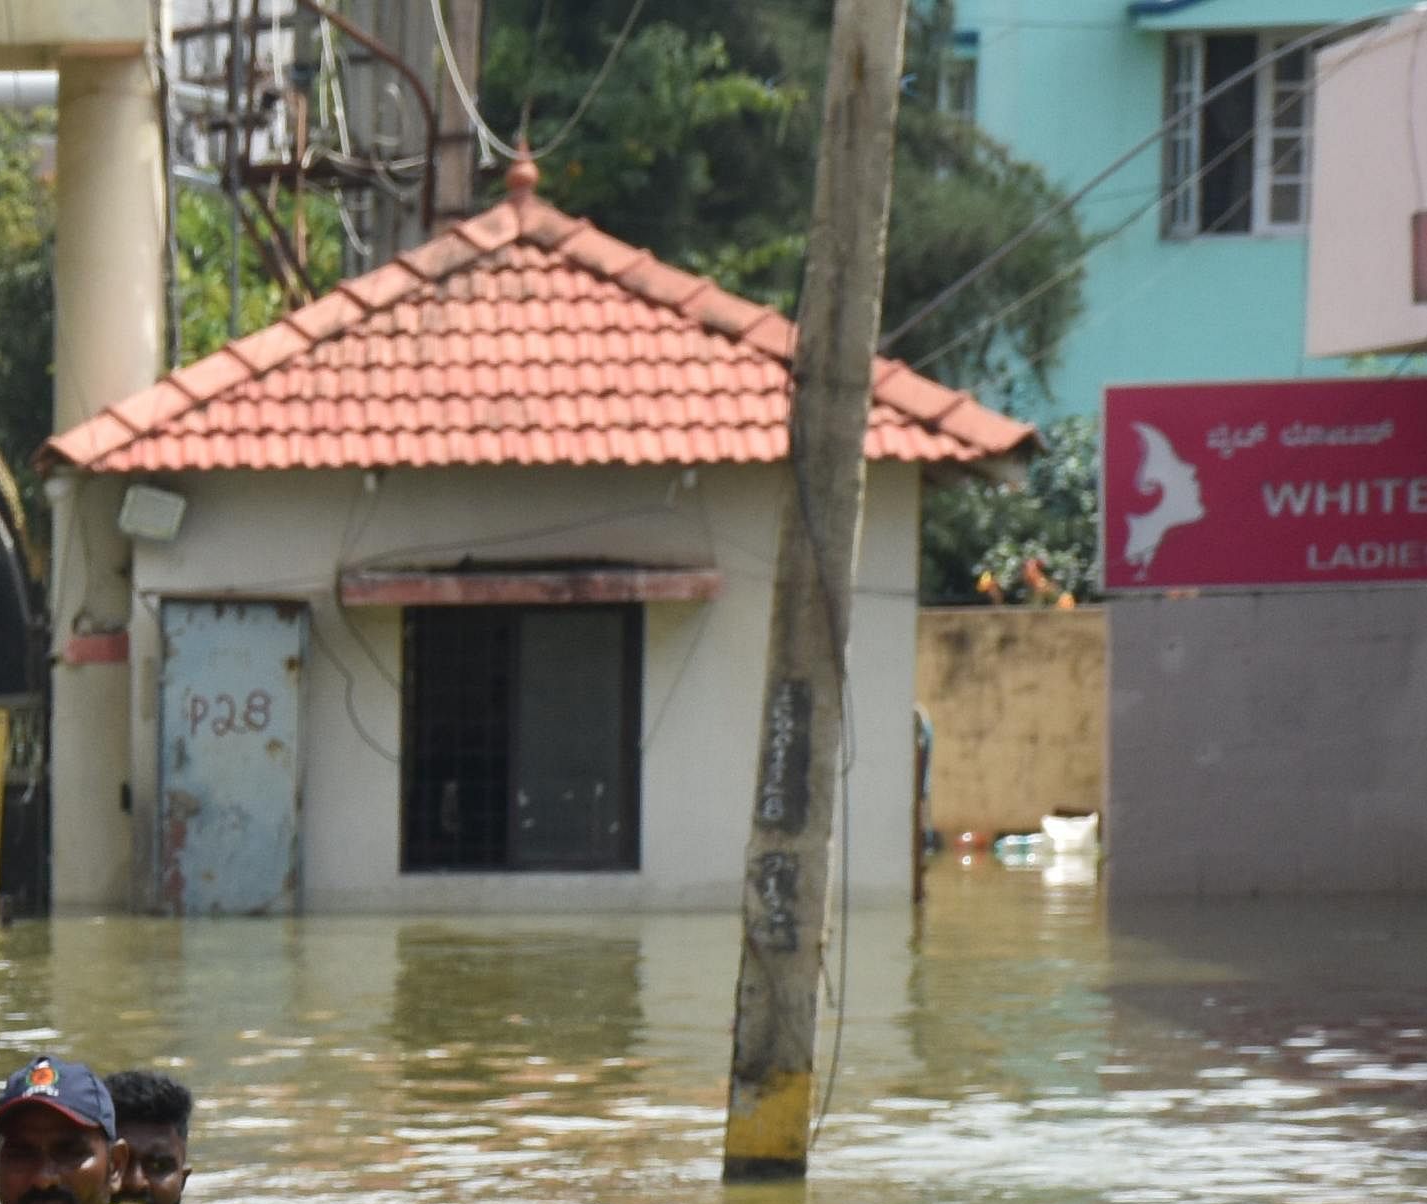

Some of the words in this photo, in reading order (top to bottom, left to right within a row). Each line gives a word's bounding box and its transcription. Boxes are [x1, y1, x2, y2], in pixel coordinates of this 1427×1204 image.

[1262, 481, 1427, 517] WHITE
[1307, 542, 1427, 570] LADIE
[189, 688, 272, 737] P28
